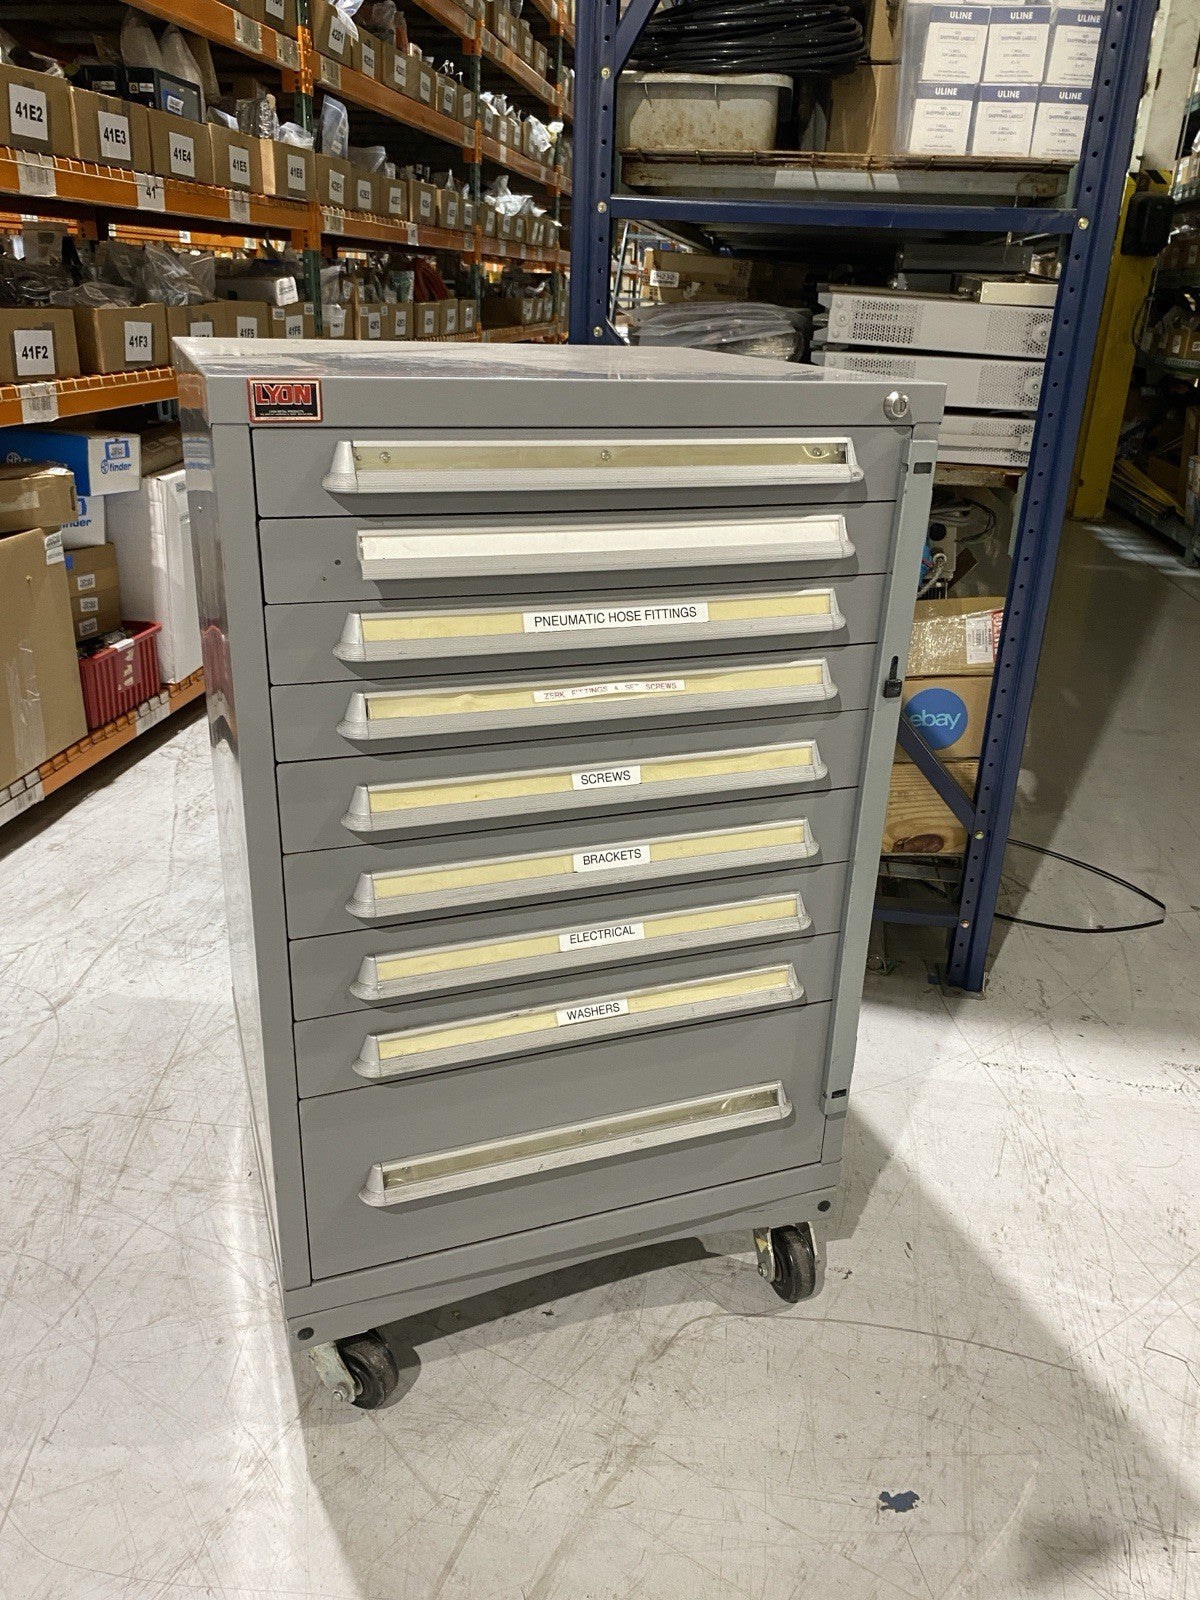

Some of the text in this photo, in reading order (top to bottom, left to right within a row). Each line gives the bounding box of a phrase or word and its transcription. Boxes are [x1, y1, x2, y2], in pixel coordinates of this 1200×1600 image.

[949, 11, 973, 20] ULINE
[1010, 11, 1034, 20] ULINE
[1077, 13, 1101, 23] ULINE
[934, 87, 958, 96] ULINE
[997, 90, 1020, 99] ULINE
[1058, 91, 1083, 100] ULINE
[15, 101, 43, 123] 41E2
[103, 127, 126, 145] 41E3
[173, 147, 191, 163] 41E4
[232, 158, 248, 173] 41E5
[290, 166, 303, 179] 41E6
[146, 185, 156, 199] 41
[240, 328, 254, 338] 41F5
[288, 325, 301, 335] 41F6
[129, 335, 148, 348] 41F3
[21, 345, 49, 360] 41F2
[254, 383, 313, 406] LYON
[109, 462, 132, 472] finder
[62, 519, 92, 529] nder
[534, 606, 698, 628] PNEUMATIC HOSE FITTINGS
[543, 691, 566, 700] ZERK
[571, 685, 608, 697] FTINGS
[645, 682, 677, 691] SCREWS
[909, 709, 962, 730] ebay
[581, 770, 631, 785] SCREWS
[583, 848, 642, 866] BRACKETS
[569, 925, 636, 944] ELECTRICAL
[566, 1002, 621, 1020] WASHERS
